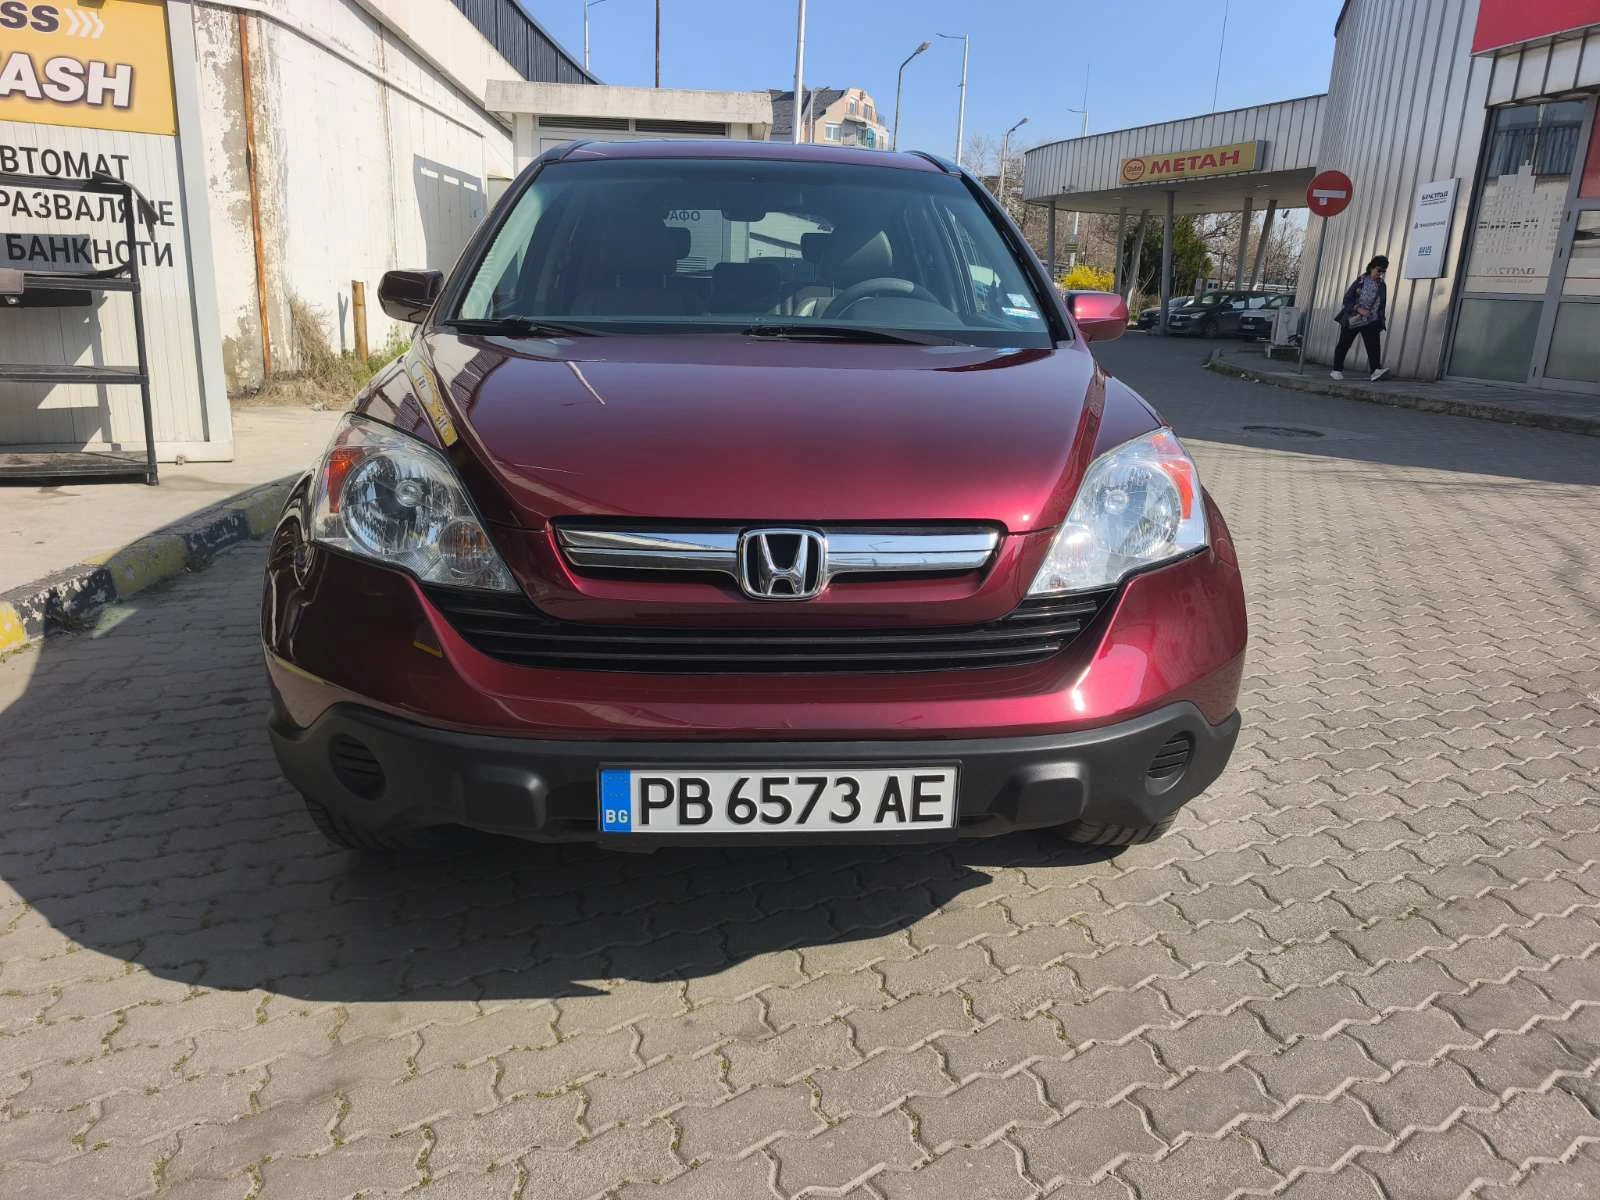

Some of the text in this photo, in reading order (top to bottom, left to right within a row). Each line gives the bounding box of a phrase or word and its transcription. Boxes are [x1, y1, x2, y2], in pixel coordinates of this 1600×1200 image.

[0, 1, 59, 33] SS
[0, 52, 132, 109] ASH
[1149, 150, 1241, 175] МЕТАН
[6, 234, 174, 268] БАНКНОТИ
[639, 774, 946, 826] PB 6573 AE
[605, 810, 628, 824] BG
